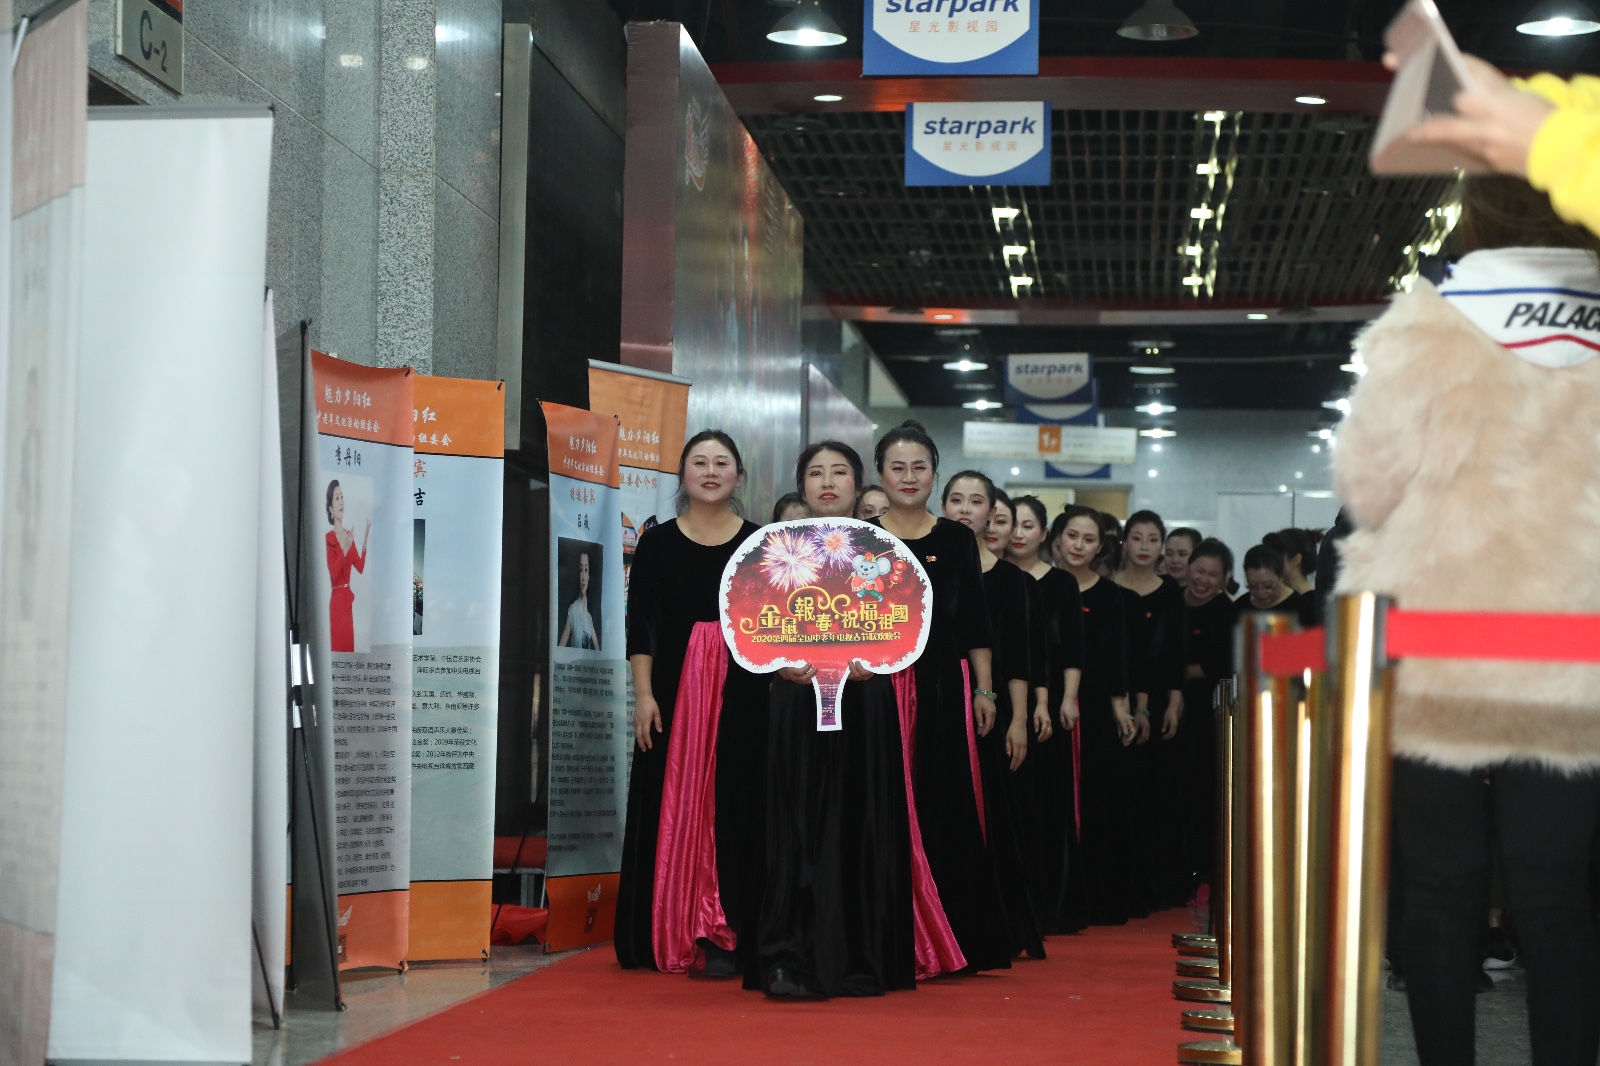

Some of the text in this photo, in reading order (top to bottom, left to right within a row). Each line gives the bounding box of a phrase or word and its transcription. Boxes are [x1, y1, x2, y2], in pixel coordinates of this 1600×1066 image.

[886, 0, 1020, 18] starpark
[909, 20, 998, 33] 星光影视园
[140, 10, 167, 73] C-2
[923, 117, 1036, 138] starpark
[1504, 302, 1600, 331] PALAC
[1014, 362, 1084, 376] starpark
[325, 384, 372, 408] 魅力夕阳红
[334, 444, 362, 467] 李丹阳
[414, 487, 426, 506] 吉
